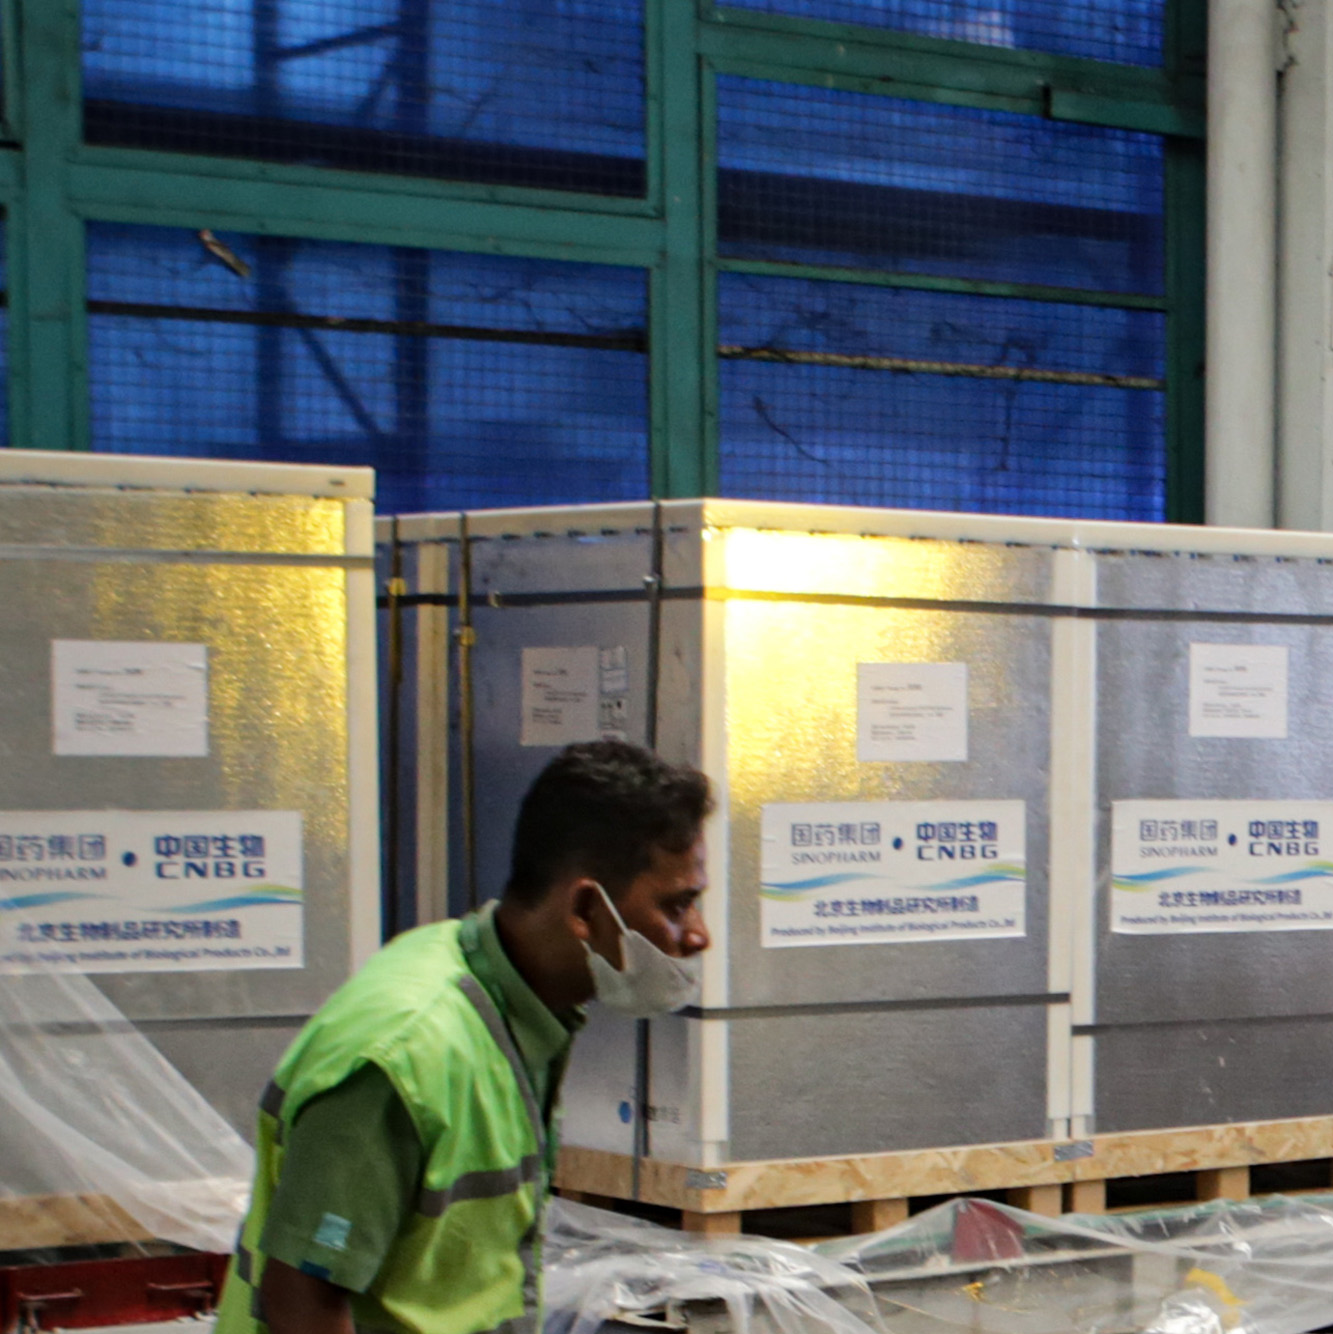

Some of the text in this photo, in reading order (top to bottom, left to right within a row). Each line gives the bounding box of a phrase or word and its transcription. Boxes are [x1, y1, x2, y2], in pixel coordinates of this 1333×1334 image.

[791, 820, 998, 846] 国药集团 中国生物
[1140, 819, 1319, 841] 国药集团 中国生物
[153, 834, 265, 858] 中国生物
[791, 844, 998, 865] SINOPHARM CNBG
[1140, 842, 1319, 858] SINOPHARM CNBG
[154, 861, 265, 879] CNBG
